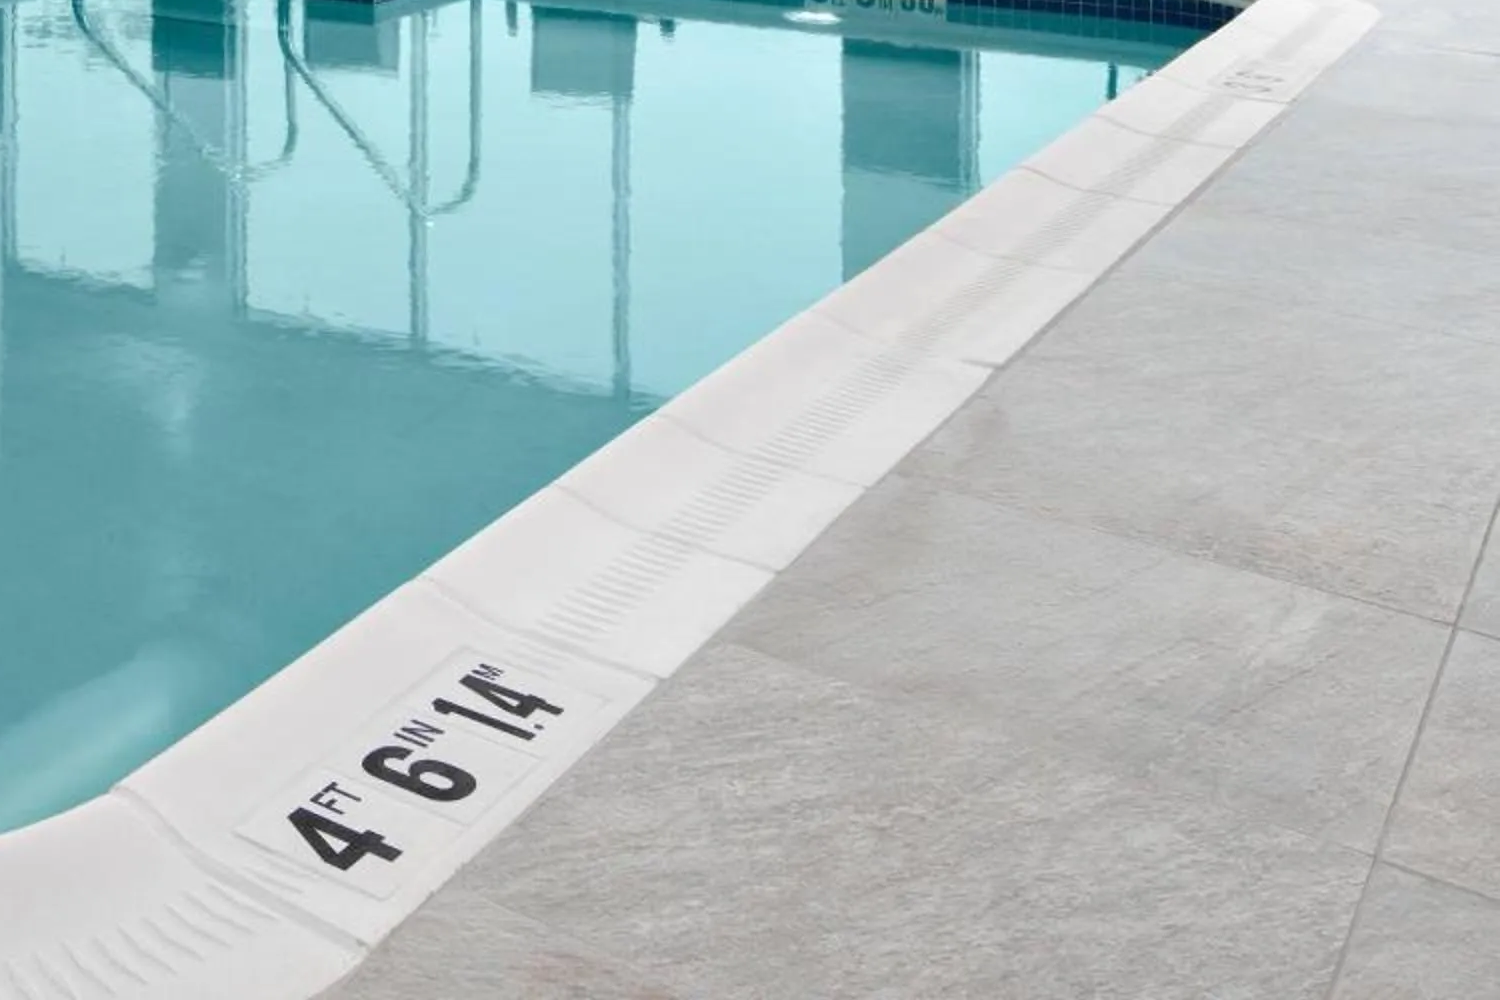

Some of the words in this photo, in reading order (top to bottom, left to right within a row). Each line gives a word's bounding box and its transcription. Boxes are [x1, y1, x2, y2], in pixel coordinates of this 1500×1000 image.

[394, 719, 445, 748] IN
[431, 674, 565, 741] 1.4
[310, 781, 362, 815] FT
[361, 745, 477, 802] 6
[287, 806, 404, 871] 4
